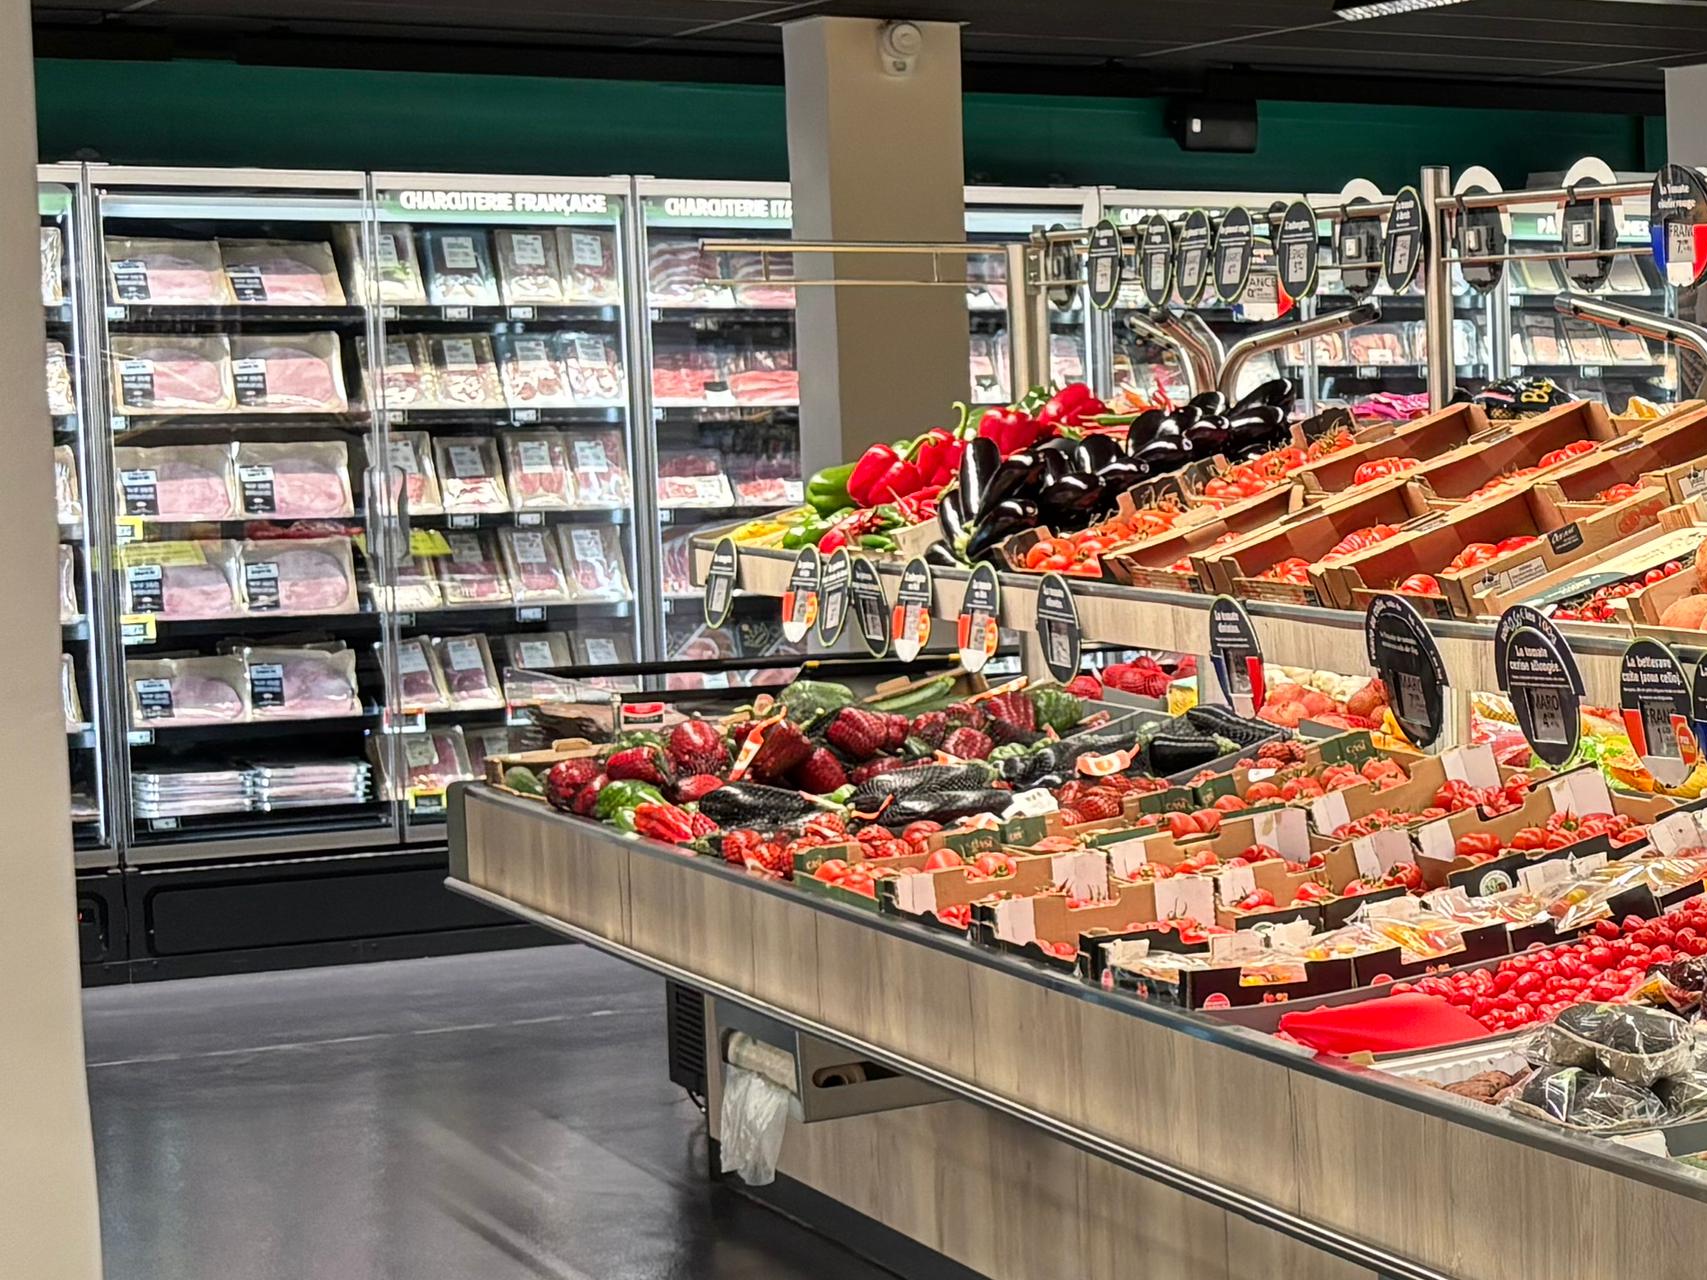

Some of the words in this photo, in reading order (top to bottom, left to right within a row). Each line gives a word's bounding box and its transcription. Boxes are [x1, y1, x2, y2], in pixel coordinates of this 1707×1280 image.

[400, 190, 512, 211] CHARCUTERIE
[515, 192, 608, 217] FRANÇAISE
[665, 197, 768, 218] CHARCUTERIE
[1515, 644, 1524, 657] La
[1626, 655, 1635, 668] La
[1636, 655, 1672, 669] betterave
